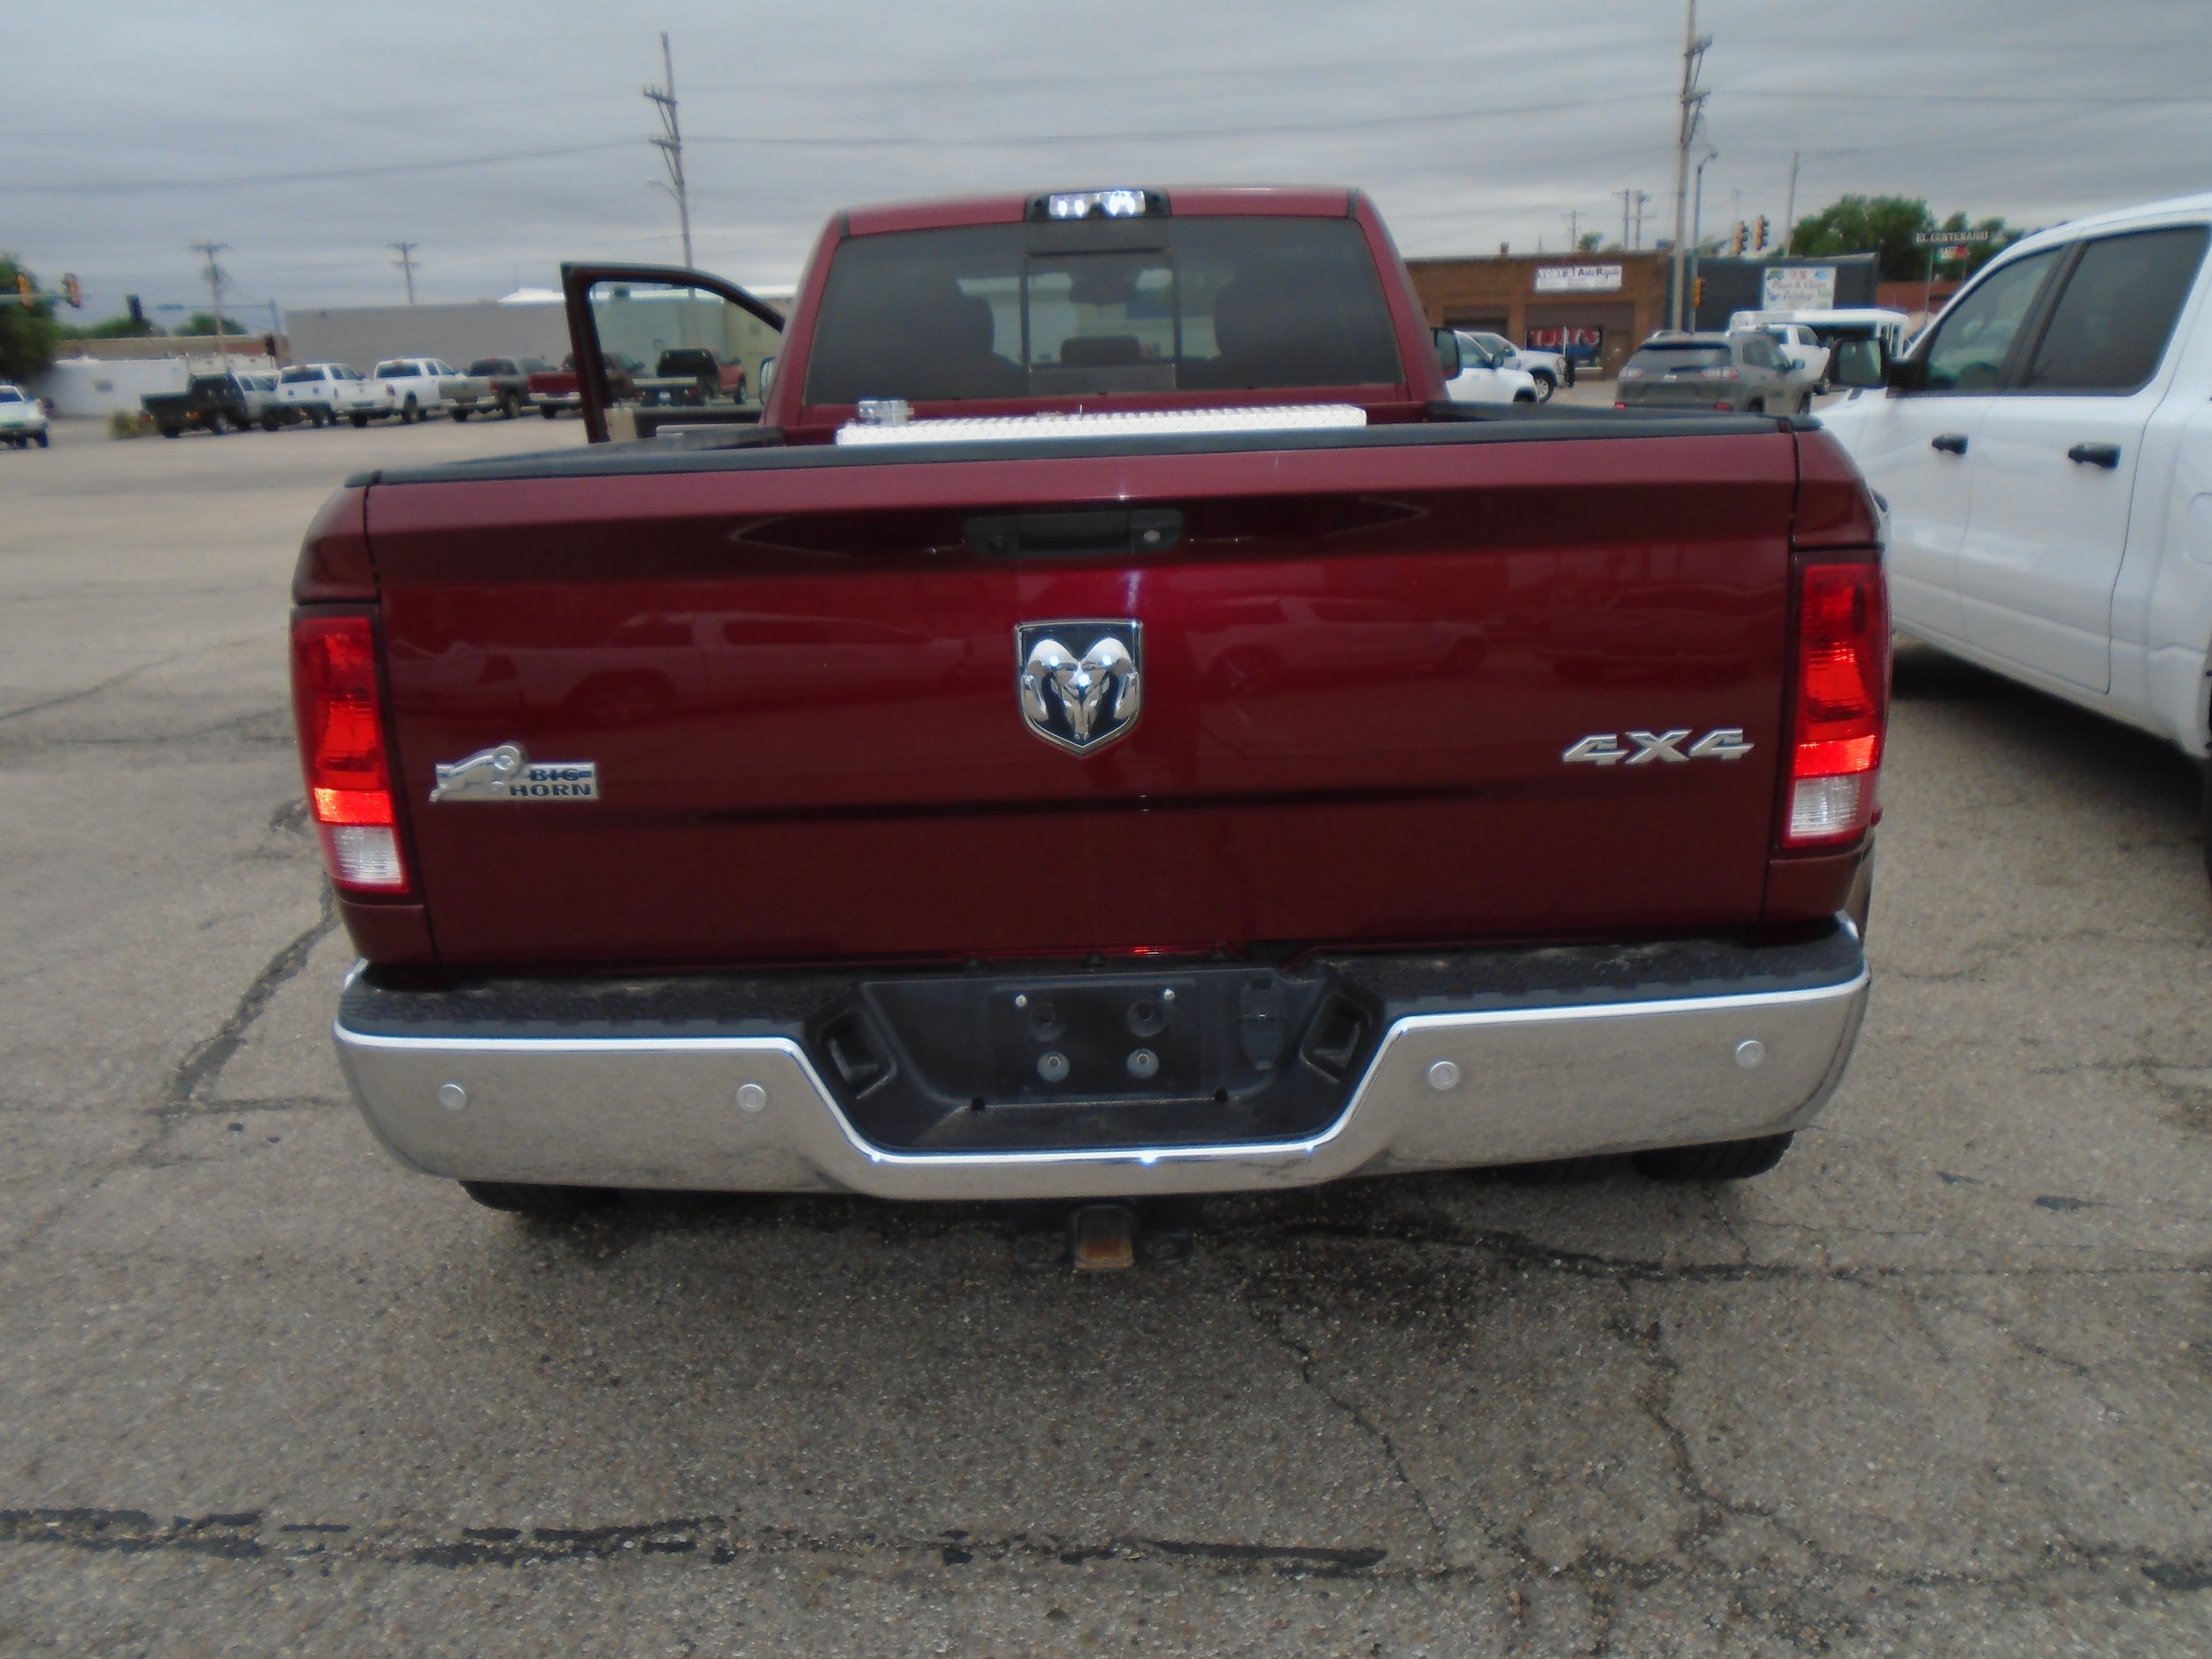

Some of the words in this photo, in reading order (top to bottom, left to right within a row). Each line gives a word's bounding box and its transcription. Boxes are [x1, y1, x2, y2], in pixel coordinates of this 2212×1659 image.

[1563, 727, 1755, 765] 4X4
[529, 768, 580, 781] BIG
[510, 783, 592, 796] HORN
